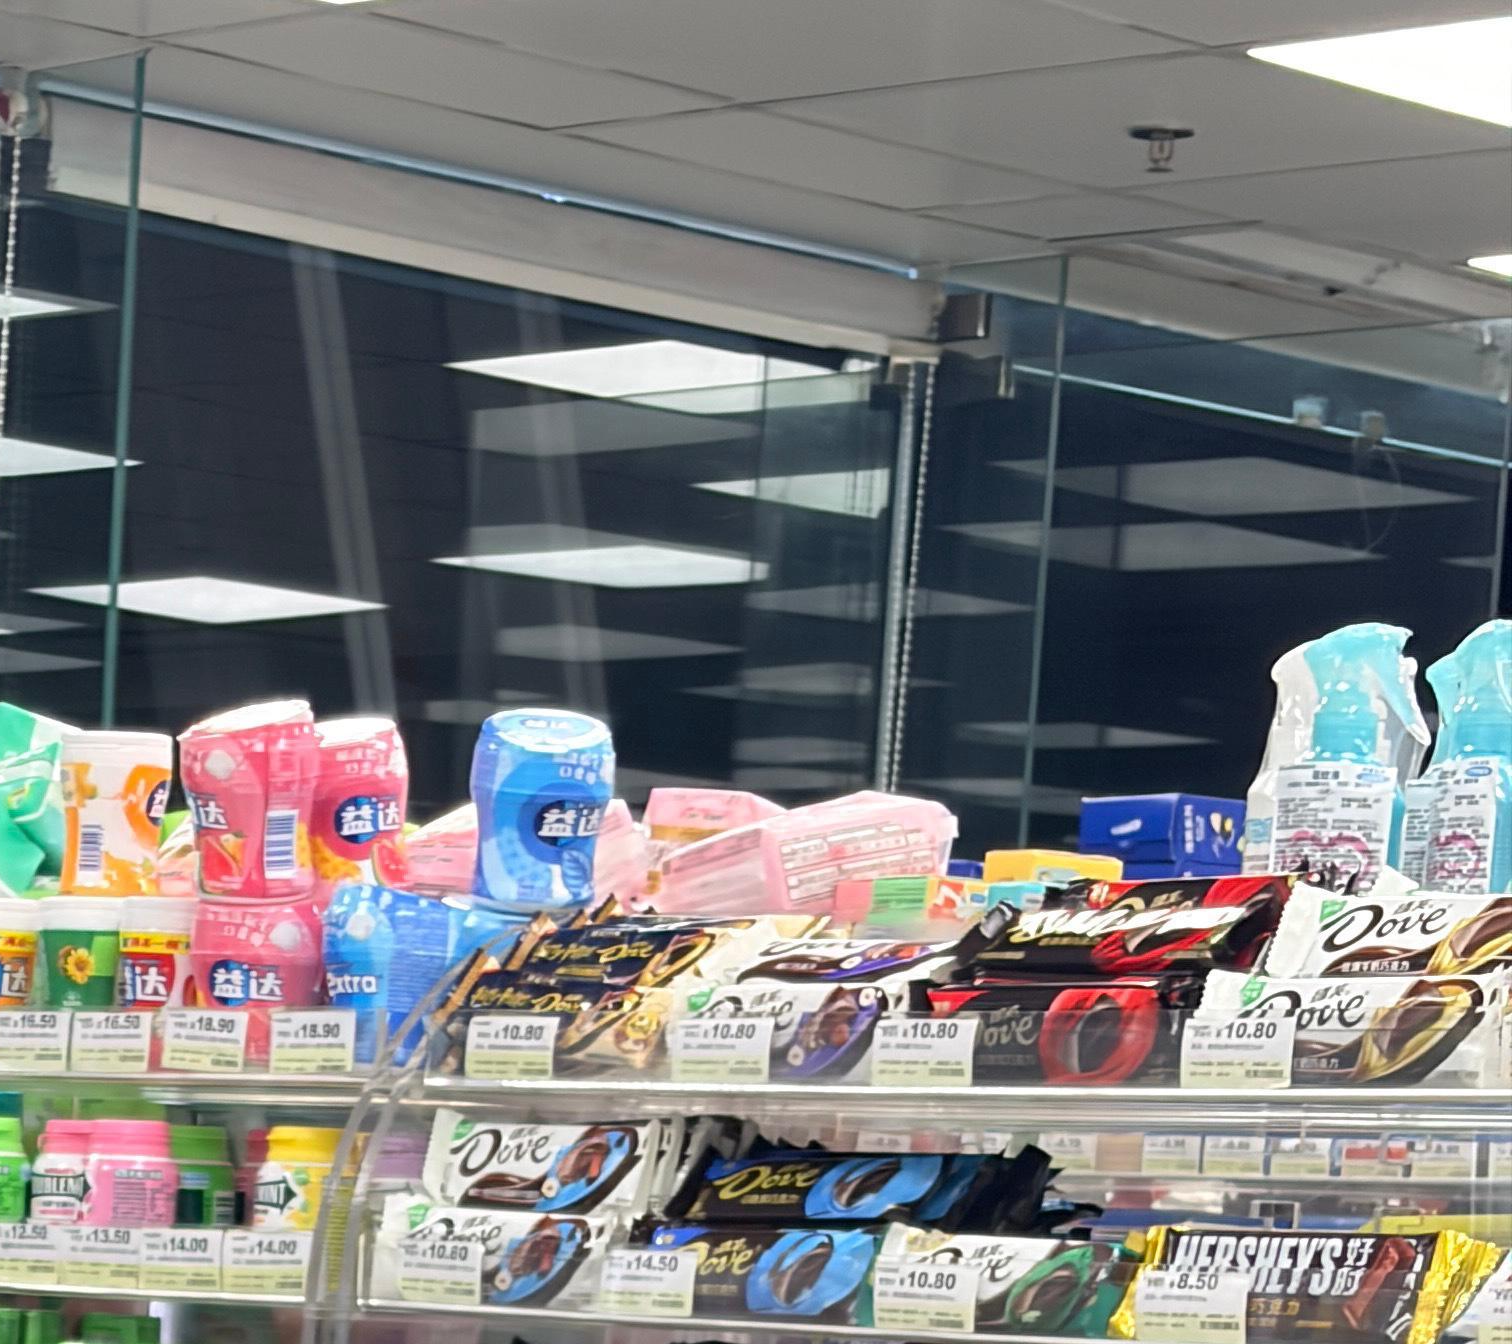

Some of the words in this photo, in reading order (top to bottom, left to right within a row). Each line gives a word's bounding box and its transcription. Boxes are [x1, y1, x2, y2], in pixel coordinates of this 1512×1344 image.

[1322, 903, 1453, 952] Dove
[213, 966, 283, 1001] 益达
[450, 1128, 551, 1177] Dove
[715, 1160, 816, 1201] Dove
